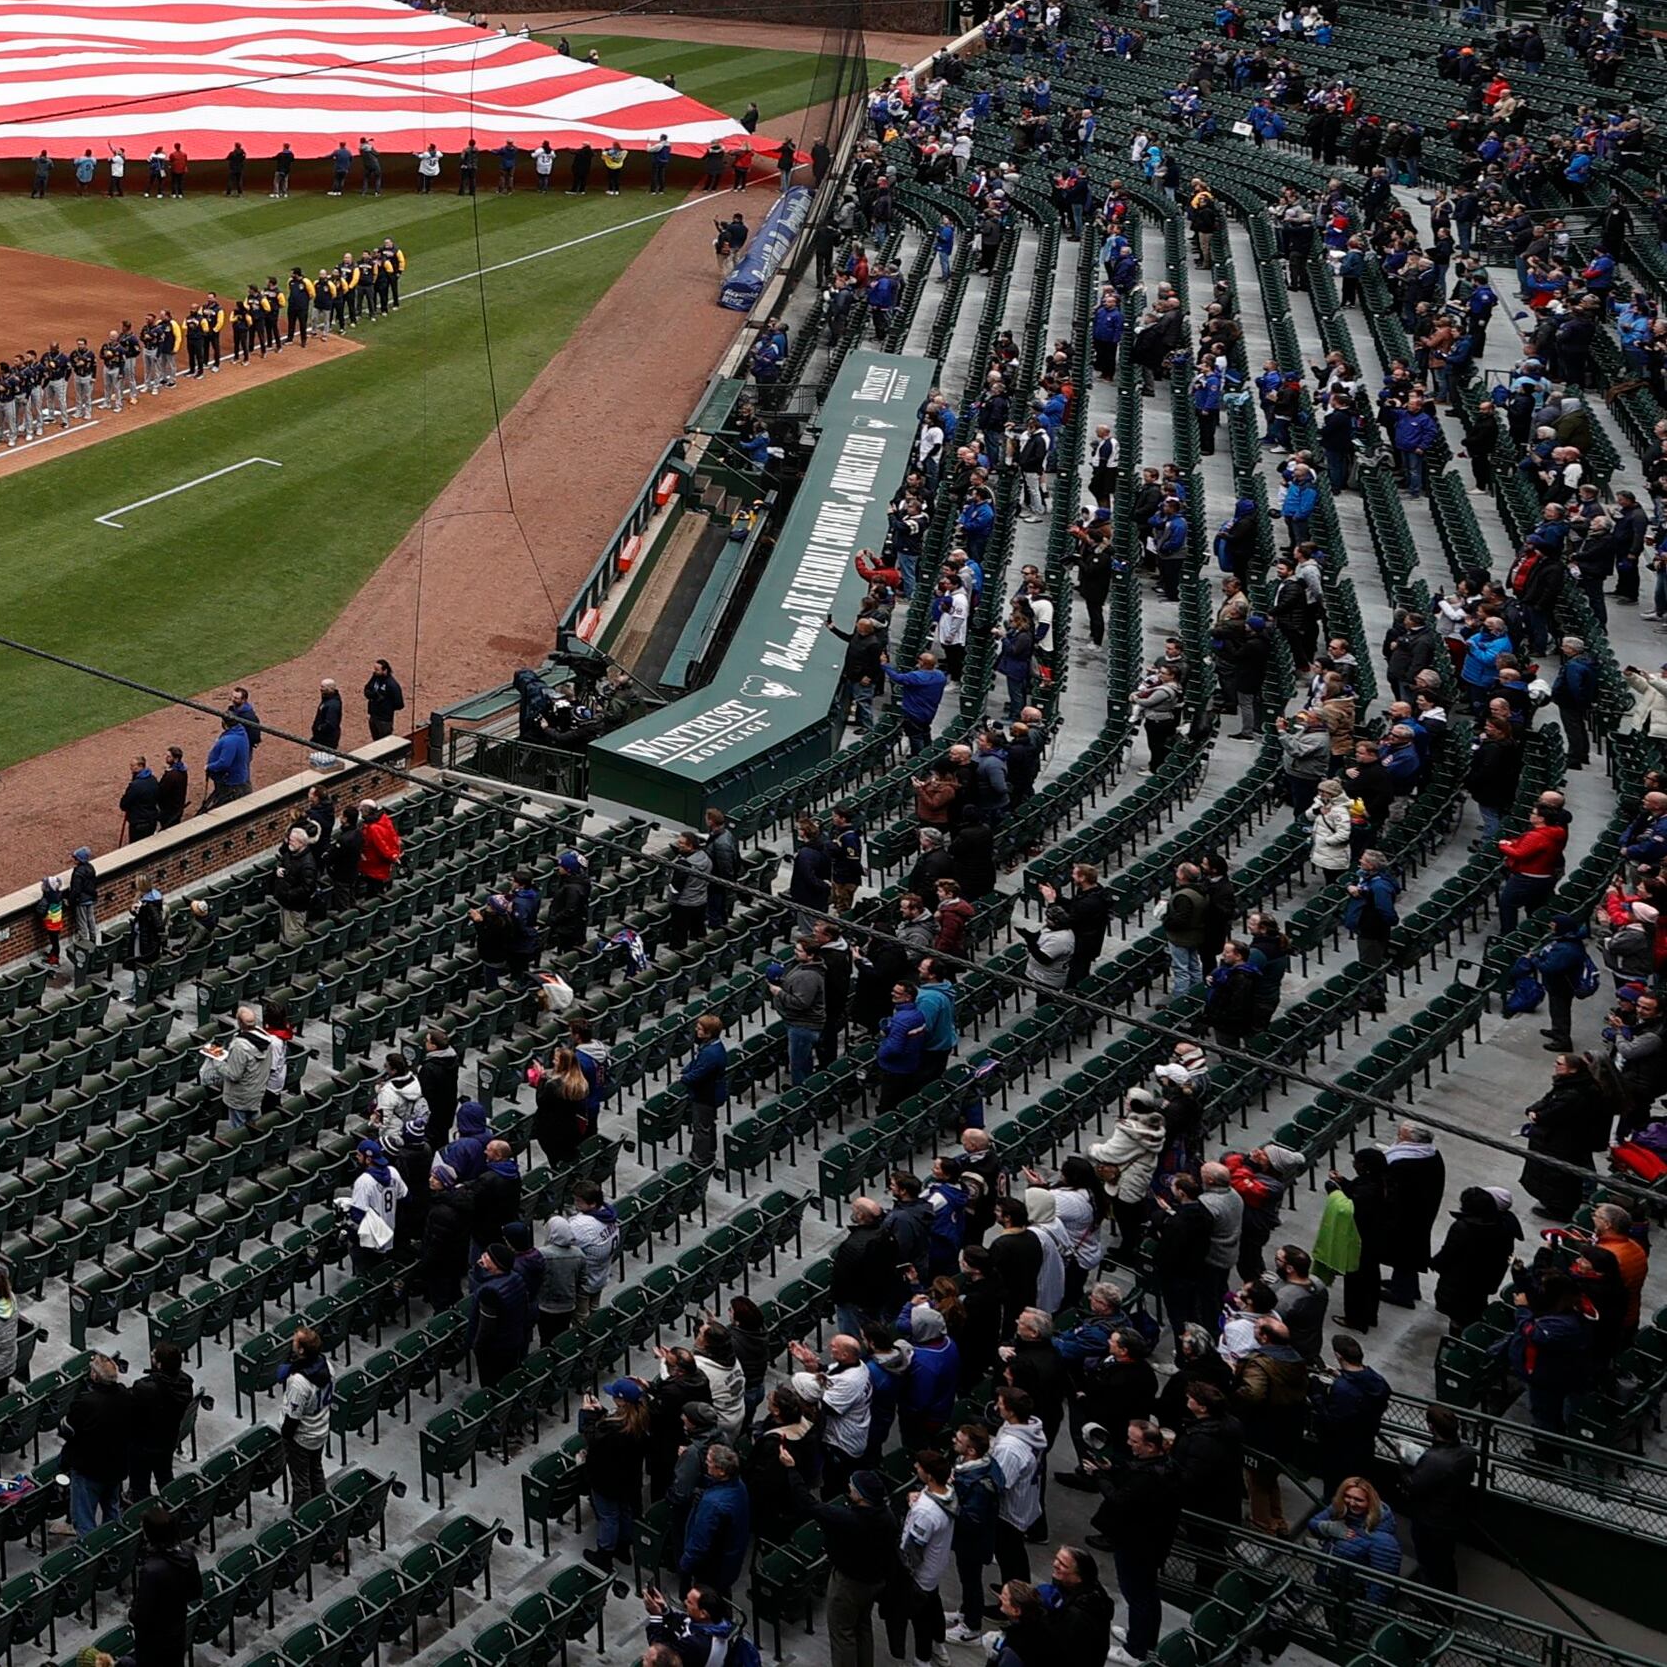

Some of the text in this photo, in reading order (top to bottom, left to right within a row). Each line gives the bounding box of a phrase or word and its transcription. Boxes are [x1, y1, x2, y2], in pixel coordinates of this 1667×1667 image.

[841, 434, 886, 459] FIELD
[829, 457, 881, 493] WRIGLEY
[810, 501, 864, 547] CONFINES
[792, 543, 850, 594] FRIENDLY
[781, 590, 834, 614] THE
[760, 622, 816, 672] Welcome
[618, 700, 757, 760] WINTRUST
[684, 720, 771, 764] MORTGAGE
[383, 1190, 393, 1213] 8
